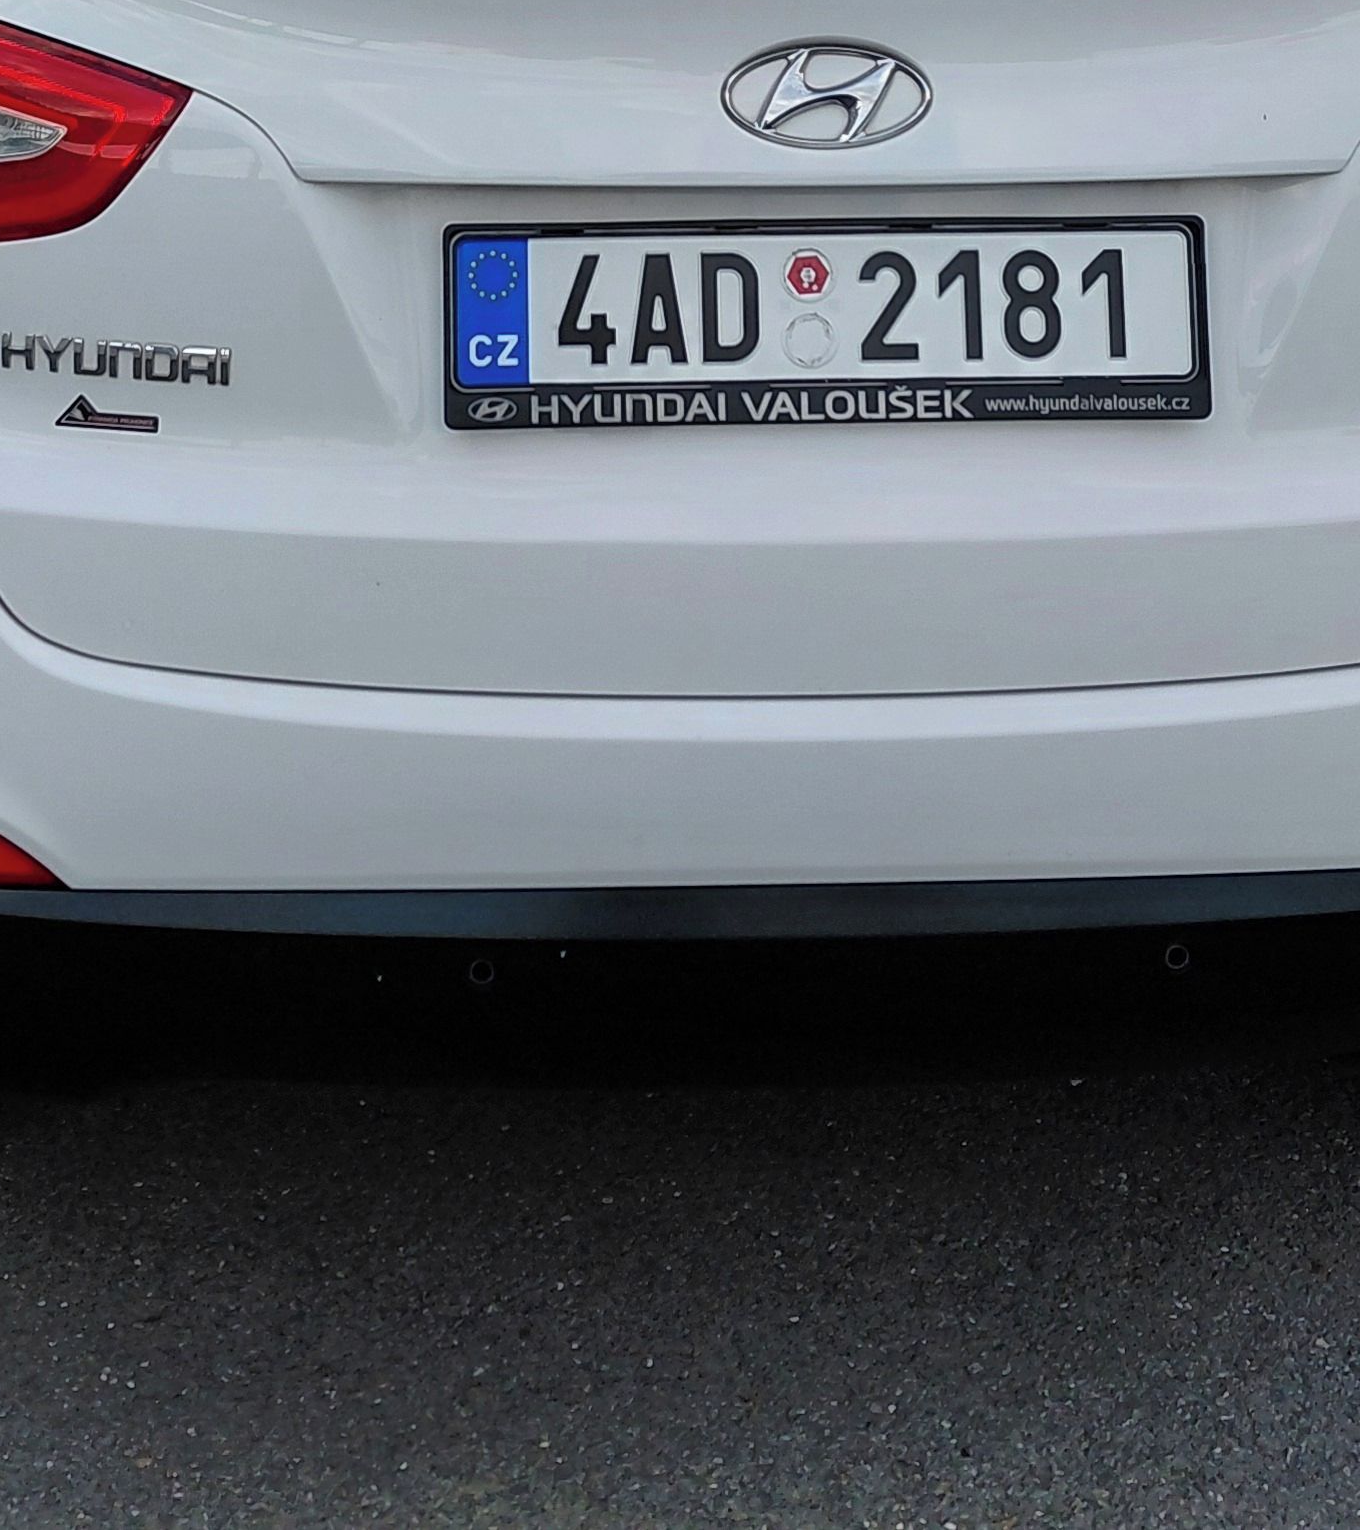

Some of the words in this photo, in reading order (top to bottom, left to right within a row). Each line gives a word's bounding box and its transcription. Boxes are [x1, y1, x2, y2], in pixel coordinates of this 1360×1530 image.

[557, 252, 761, 365] 4AD
[857, 248, 1128, 362] 2181
[1, 331, 233, 387] HYUNDAI
[467, 333, 520, 367] CZ
[530, 393, 727, 425] HYUNDAI
[741, 385, 975, 423] VALOUŠEK
[984, 392, 1191, 415] www.hyundaivalousek.cz
